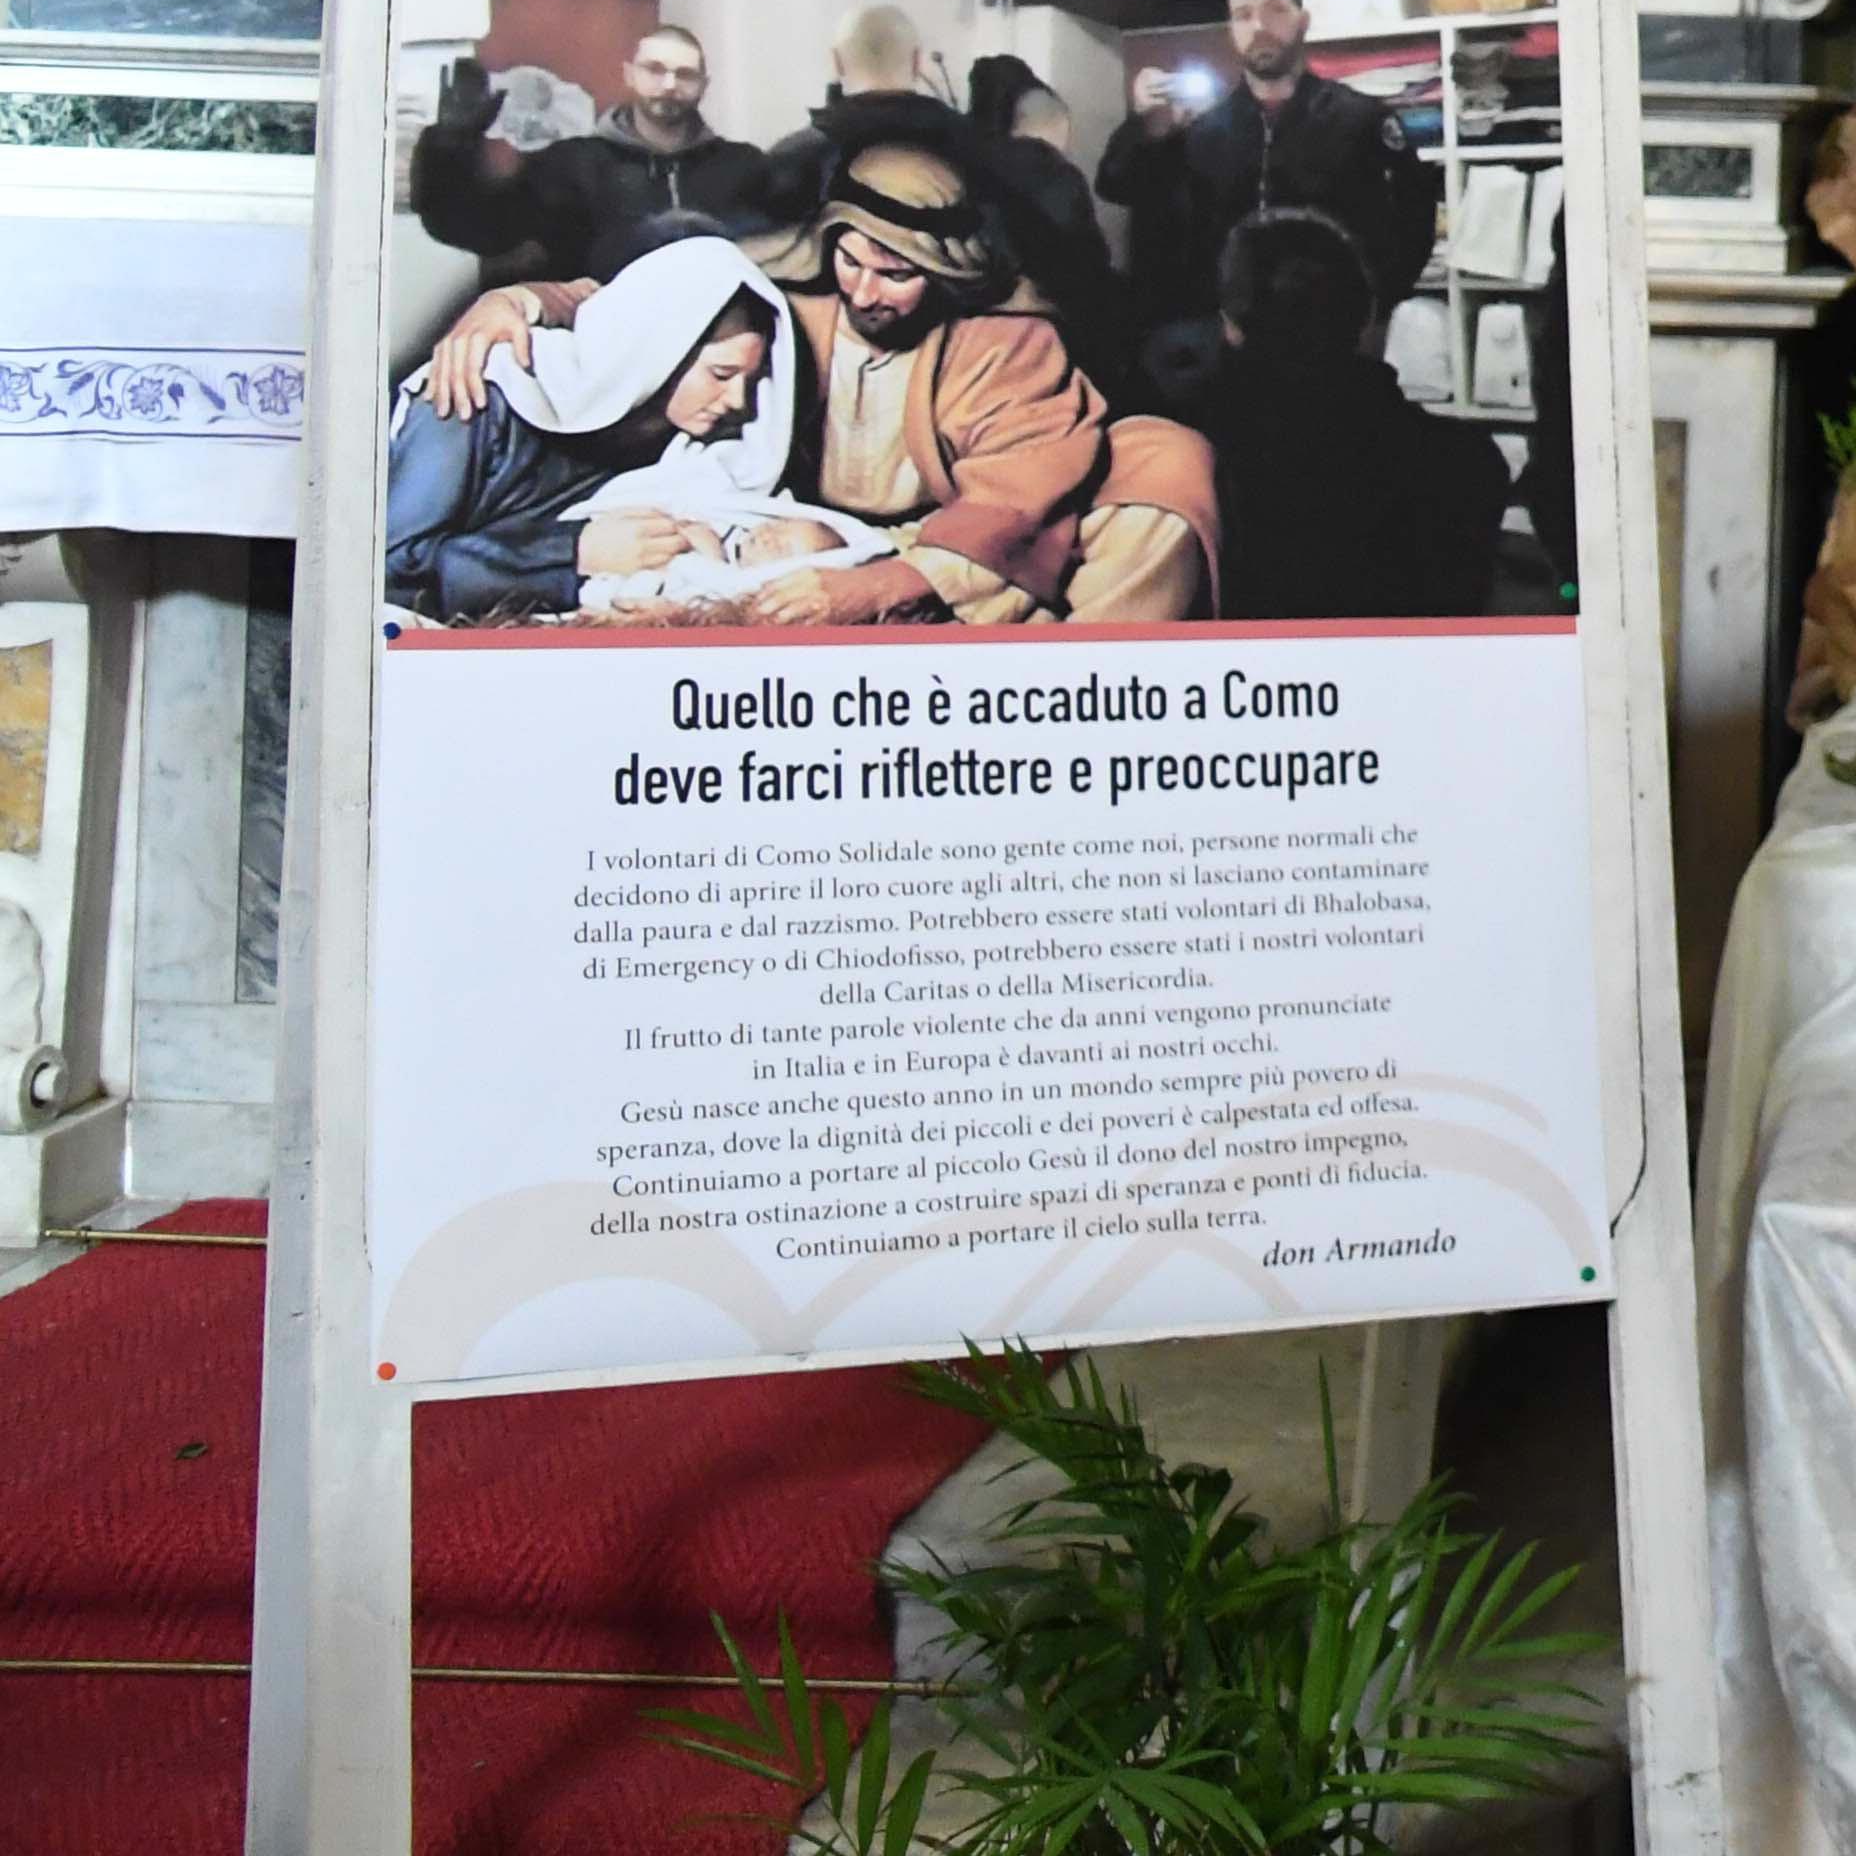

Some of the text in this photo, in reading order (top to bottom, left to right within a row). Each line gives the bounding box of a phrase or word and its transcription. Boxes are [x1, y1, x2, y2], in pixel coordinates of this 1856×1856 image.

[672, 668, 1340, 732] Quello che è accaduto a Como
[614, 746, 1380, 808] deve farci riflettere e preoccupare
[586, 822, 1419, 872] I volontari di Como Solidale sono gente come noi, persone normali che
[573, 859, 1430, 910] decidono di aprire il loro cuore agli altri, che non si lasciano contaminare
[572, 890, 1432, 949] dalla paura e dal razzismo. Potrebbero essere stati volontari di Bhalobasa,
[582, 923, 1425, 984] di Emergency o di Chiodofisso, potrebbero essere stati i nostri volontari
[1261, 1226, 1457, 1269] don Armando
